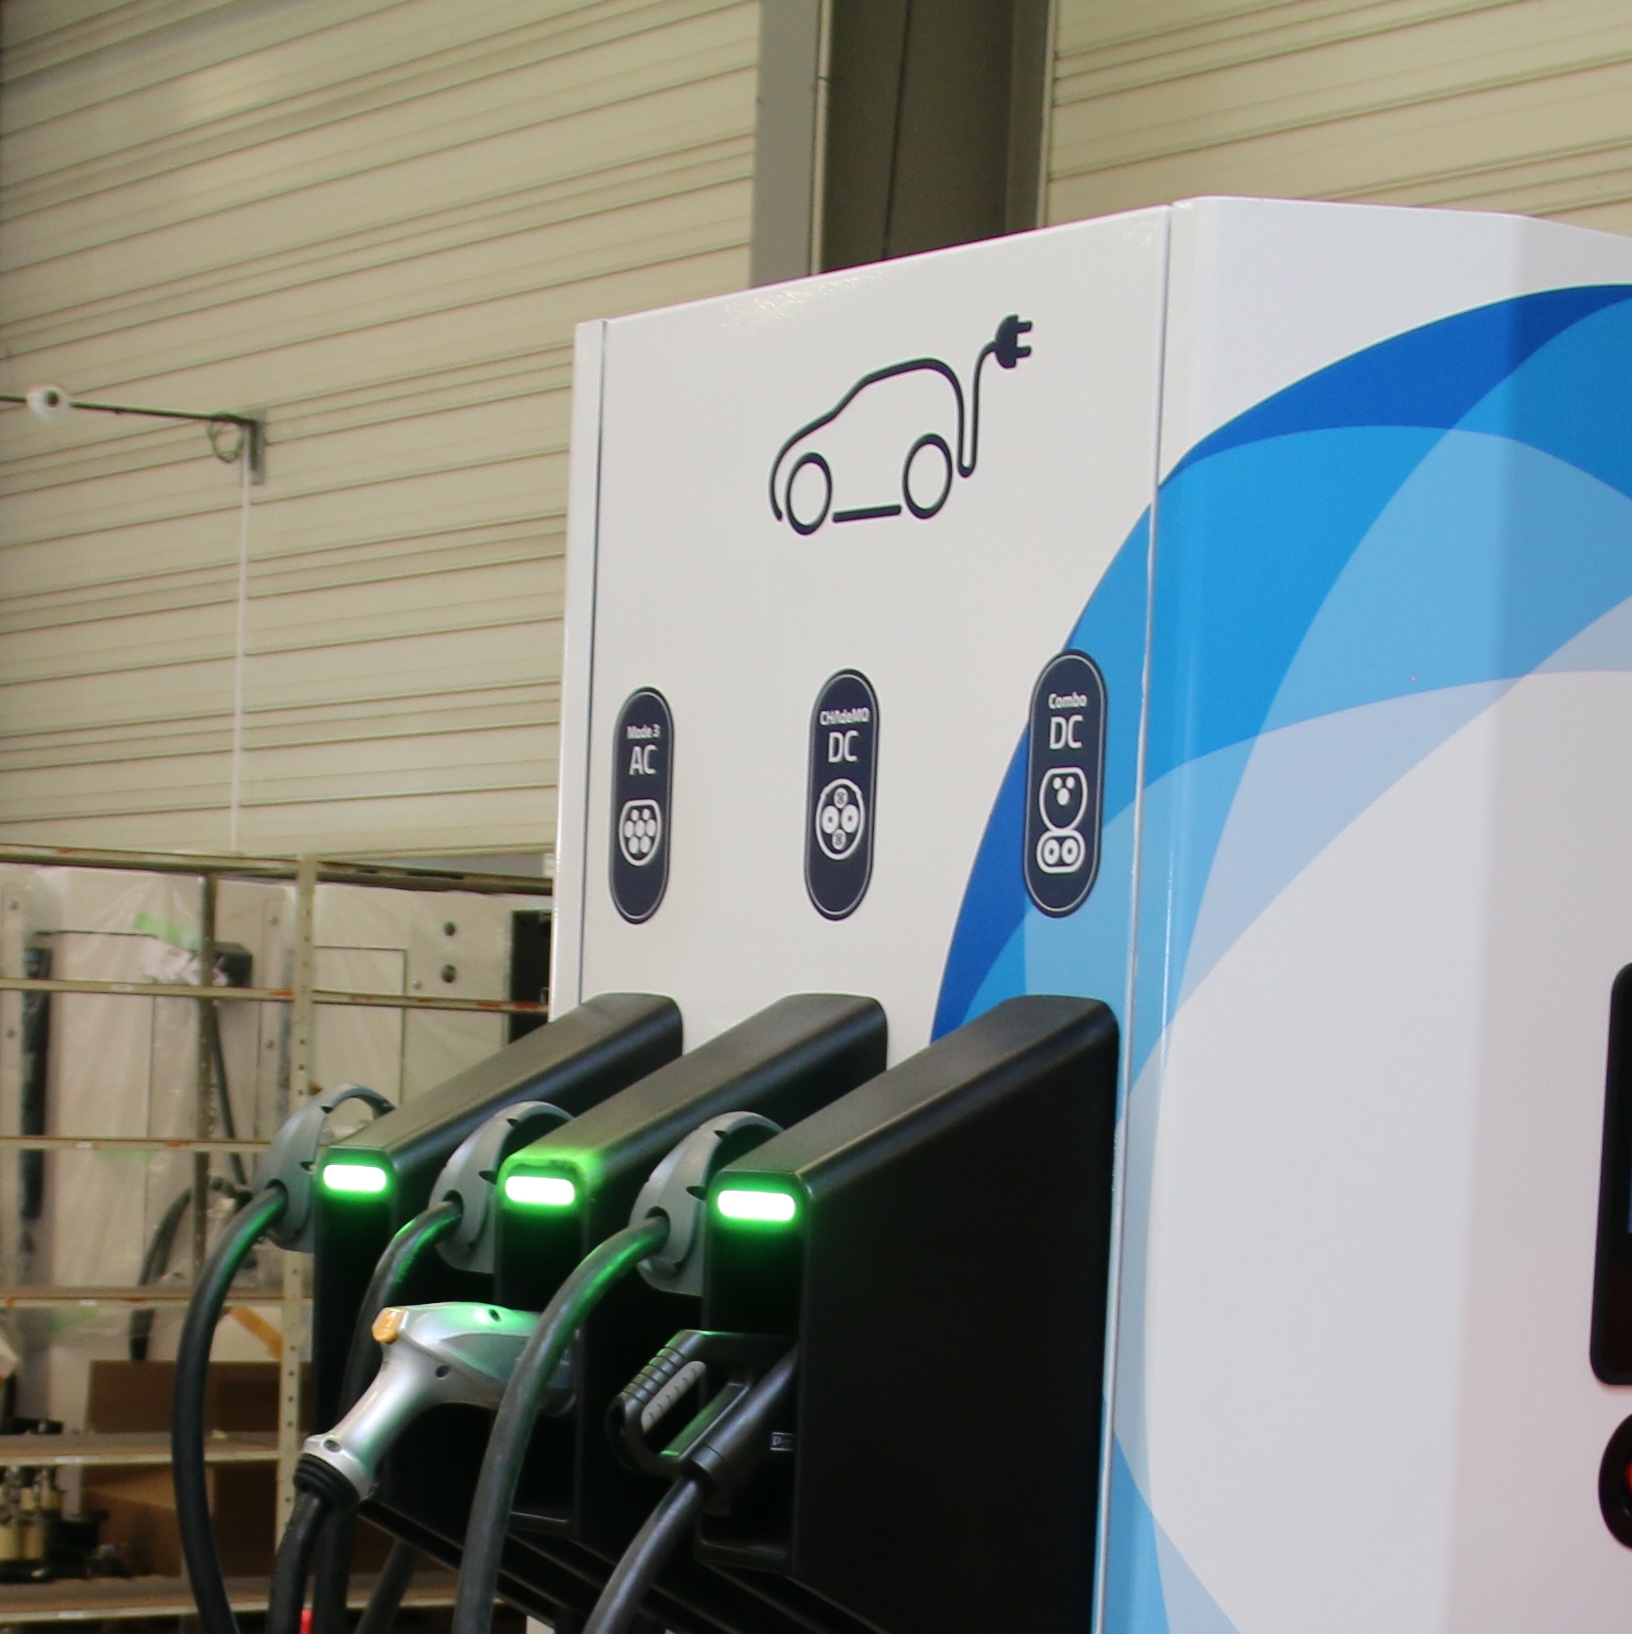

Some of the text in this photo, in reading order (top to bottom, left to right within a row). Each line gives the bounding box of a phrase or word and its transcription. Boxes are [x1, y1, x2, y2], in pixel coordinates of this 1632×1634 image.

[1048, 691, 1088, 709] Combo
[652, 723, 661, 738] 3
[828, 729, 860, 763] DC
[1049, 714, 1084, 750] DC
[629, 744, 659, 775] AC
